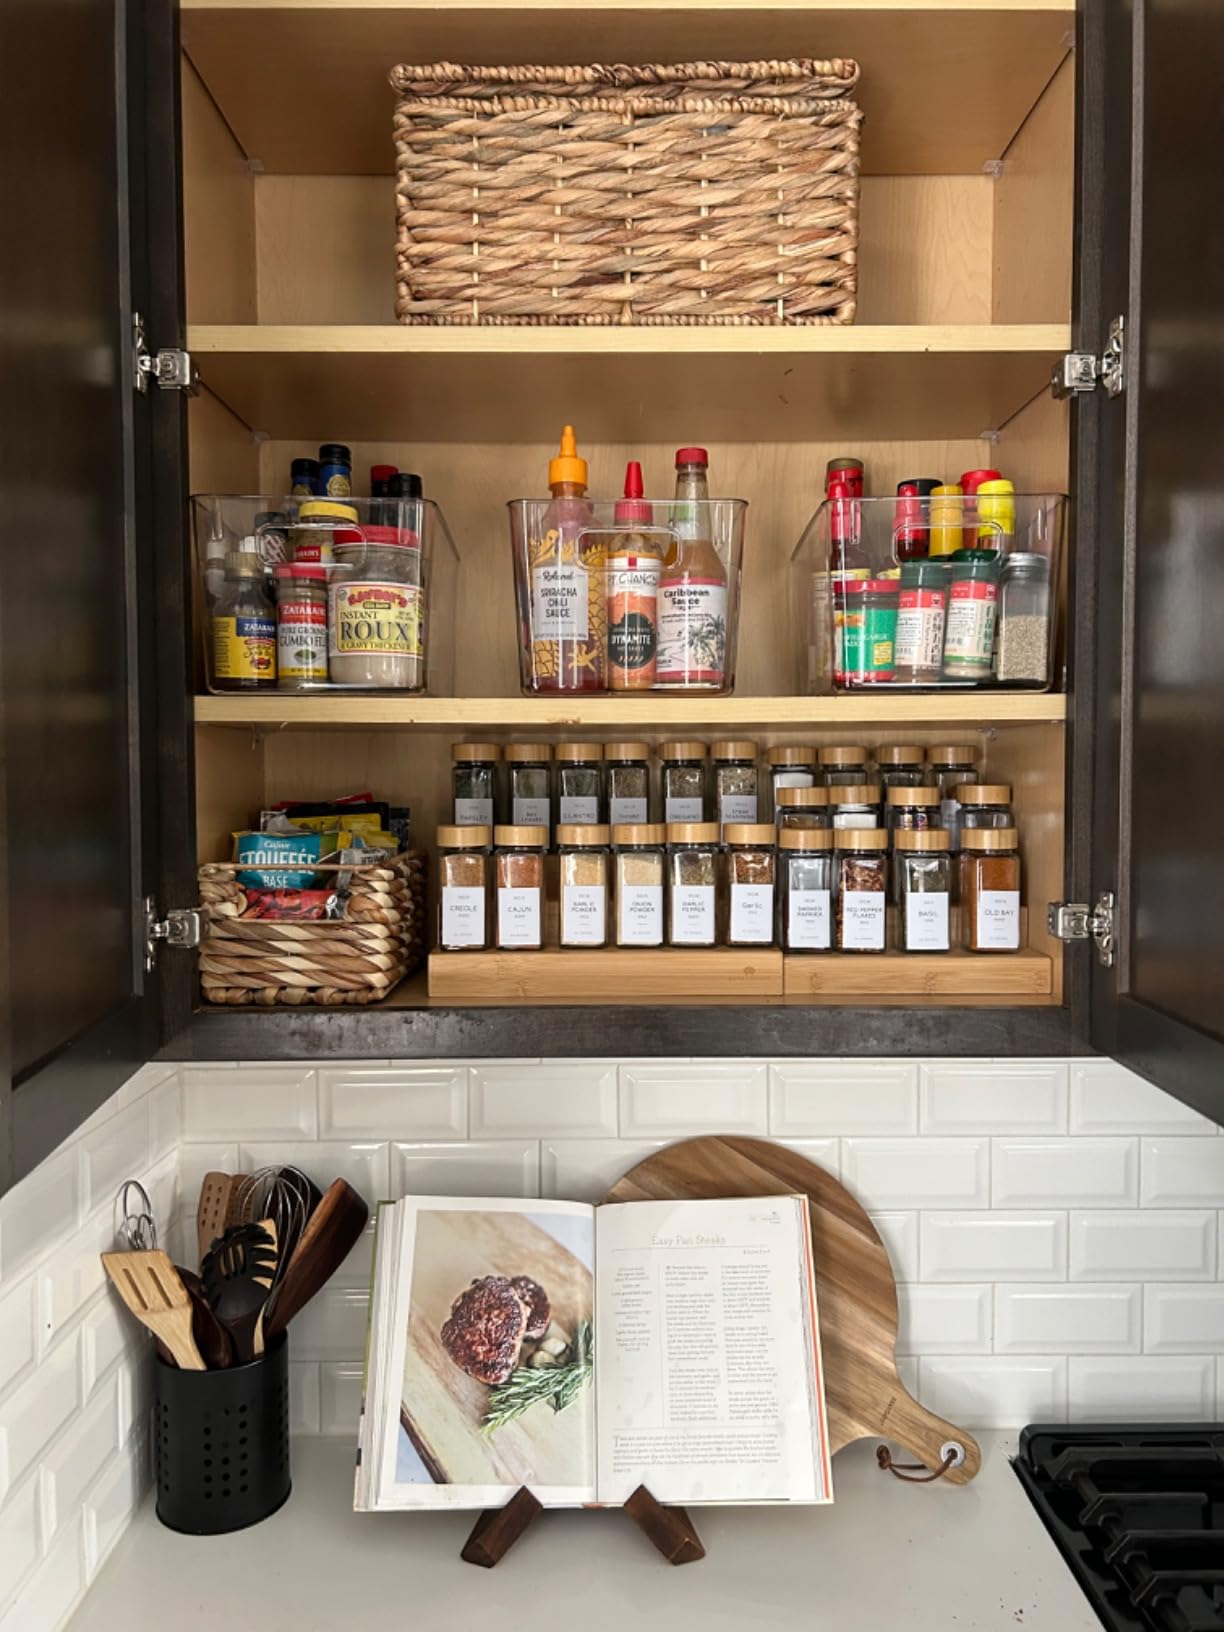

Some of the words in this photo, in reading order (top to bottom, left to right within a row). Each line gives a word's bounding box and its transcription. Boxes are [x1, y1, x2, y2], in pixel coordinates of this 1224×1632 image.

[541, 587, 577, 597] SRIRACHA
[664, 588, 709, 597] Caribbean
[545, 608, 570, 617] SAUCE
[341, 620, 408, 641] ROUX
[611, 634, 651, 645] DYNAMITE
[263, 875, 288, 888] BASE
[450, 905, 478, 913] CREOLE
[1001, 909, 1015, 917] BAY
